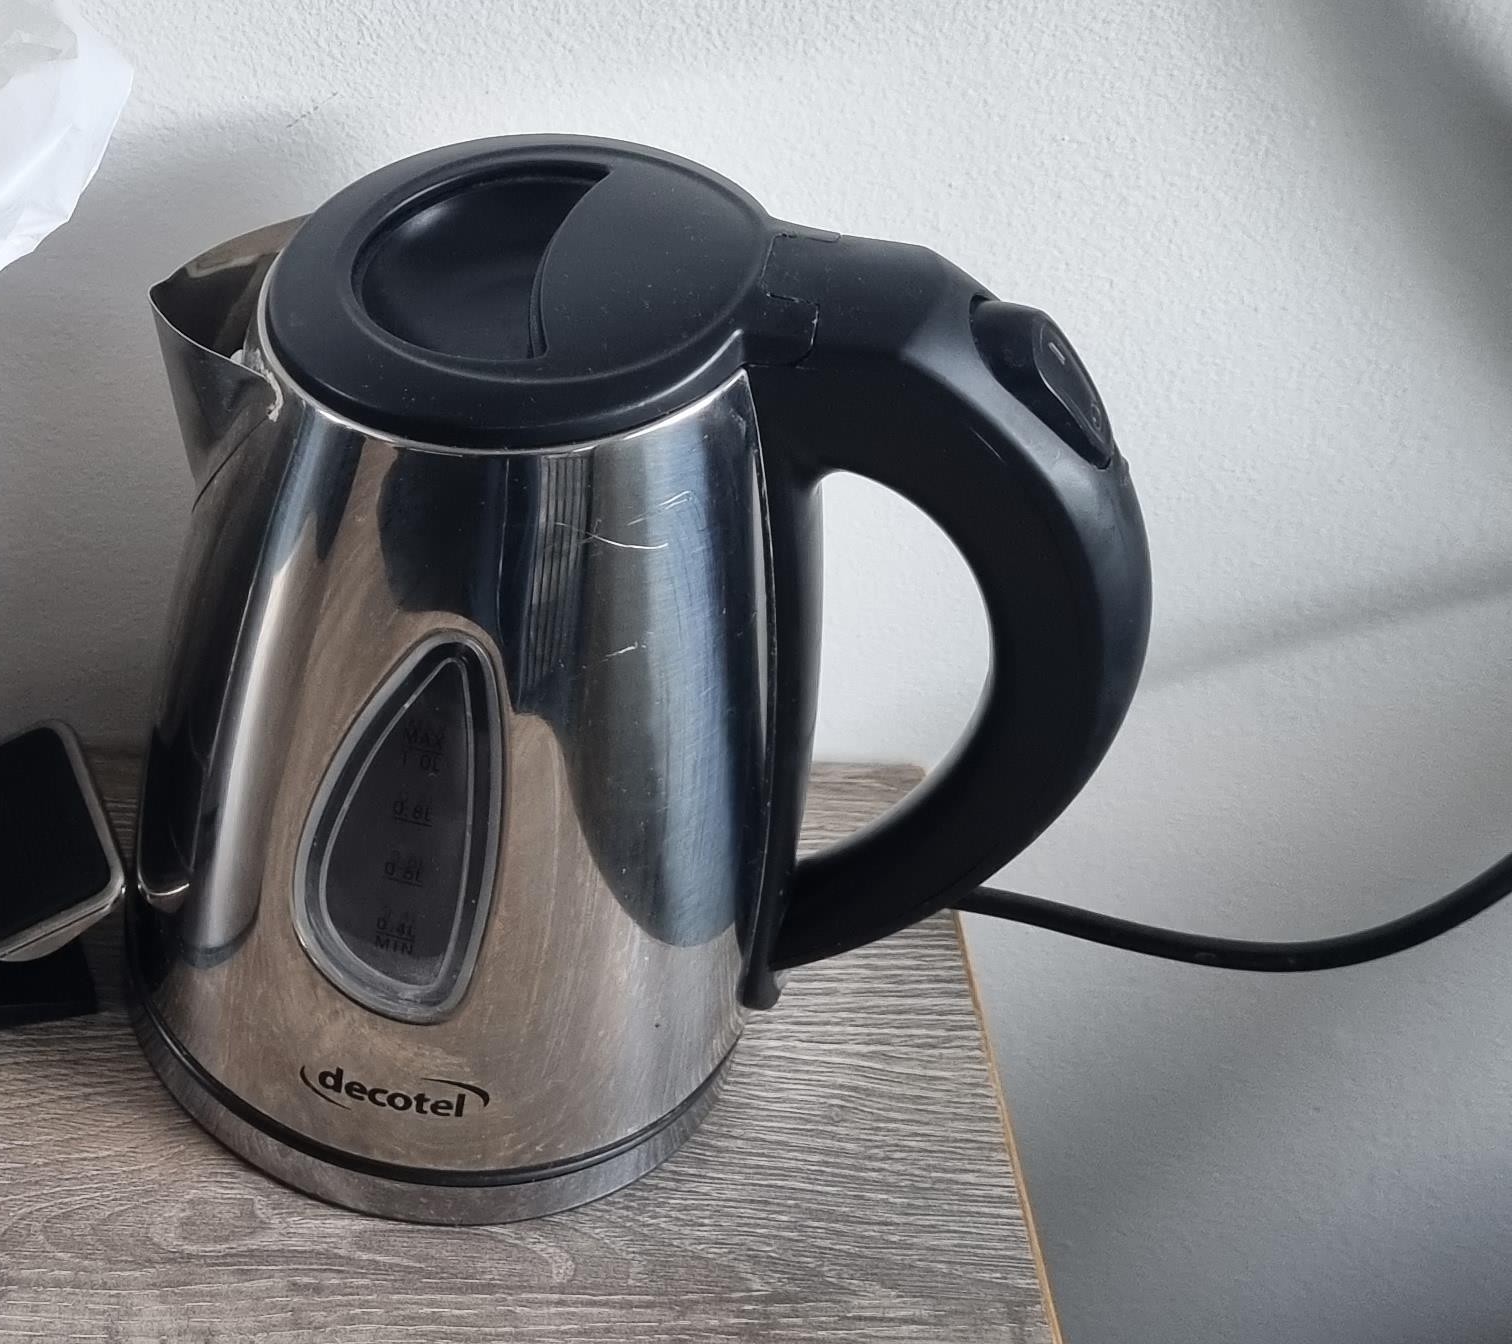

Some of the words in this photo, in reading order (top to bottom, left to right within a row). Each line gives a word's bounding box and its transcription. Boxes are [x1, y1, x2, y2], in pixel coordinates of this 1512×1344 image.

[404, 727, 446, 750] MAX
[400, 750, 440, 772] 10L
[375, 935, 414, 955] MIN
[318, 1067, 466, 1117] decotel
